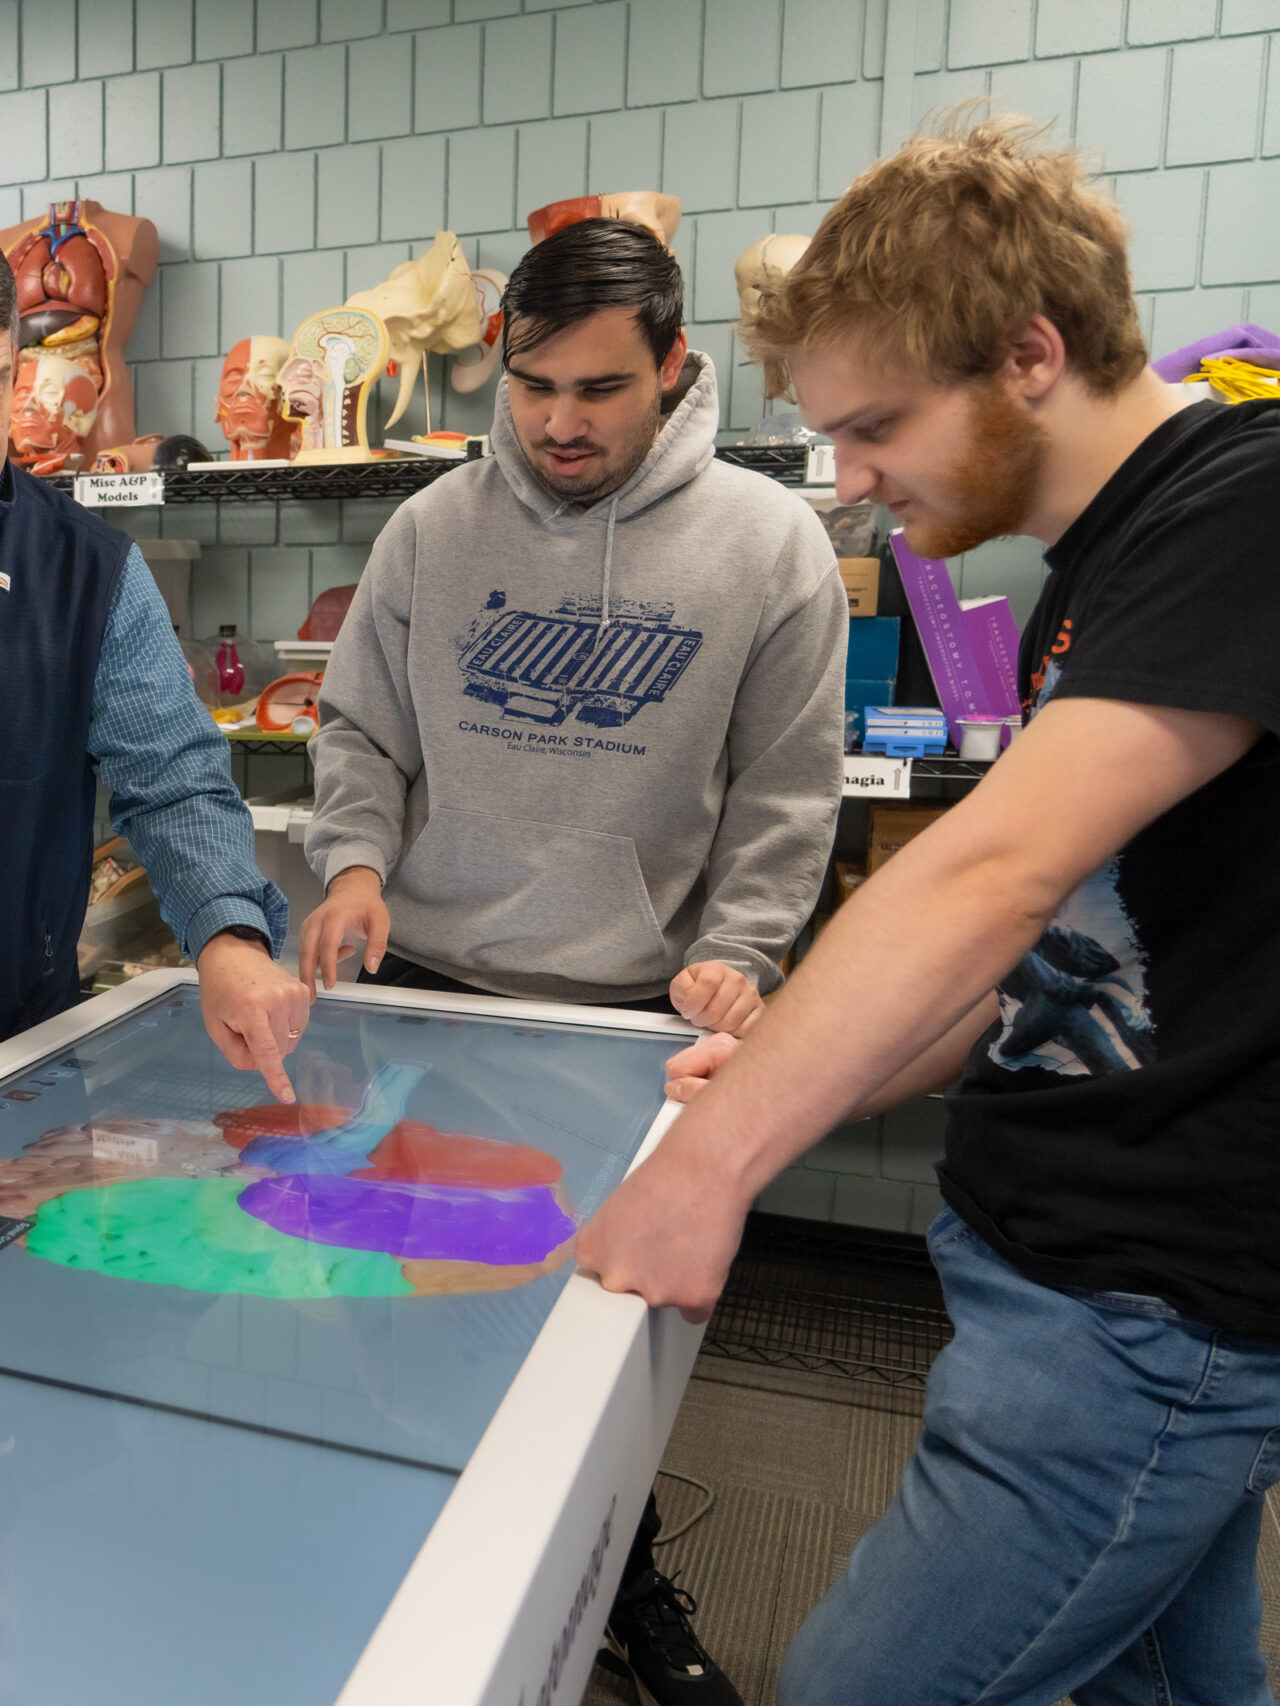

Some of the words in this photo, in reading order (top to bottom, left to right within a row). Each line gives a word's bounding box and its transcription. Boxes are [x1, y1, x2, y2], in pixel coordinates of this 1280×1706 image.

[90, 478, 116, 488] Misc
[119, 476, 147, 487] A&P
[97, 492, 139, 502] Models
[924, 564, 963, 669] RACHEOSTOMY
[473, 647, 494, 666] EAU
[490, 619, 524, 647] CLAIRE
[674, 640, 697, 659] EAU
[647, 661, 681, 697] CLAIRE
[458, 720, 523, 742] CARSON
[527, 732, 568, 746] PARK
[573, 736, 647, 756] STADIUM
[506, 741, 522, 751] Eau
[523, 744, 547, 754] Claire,
[549, 746, 591, 758] Wisconsin
